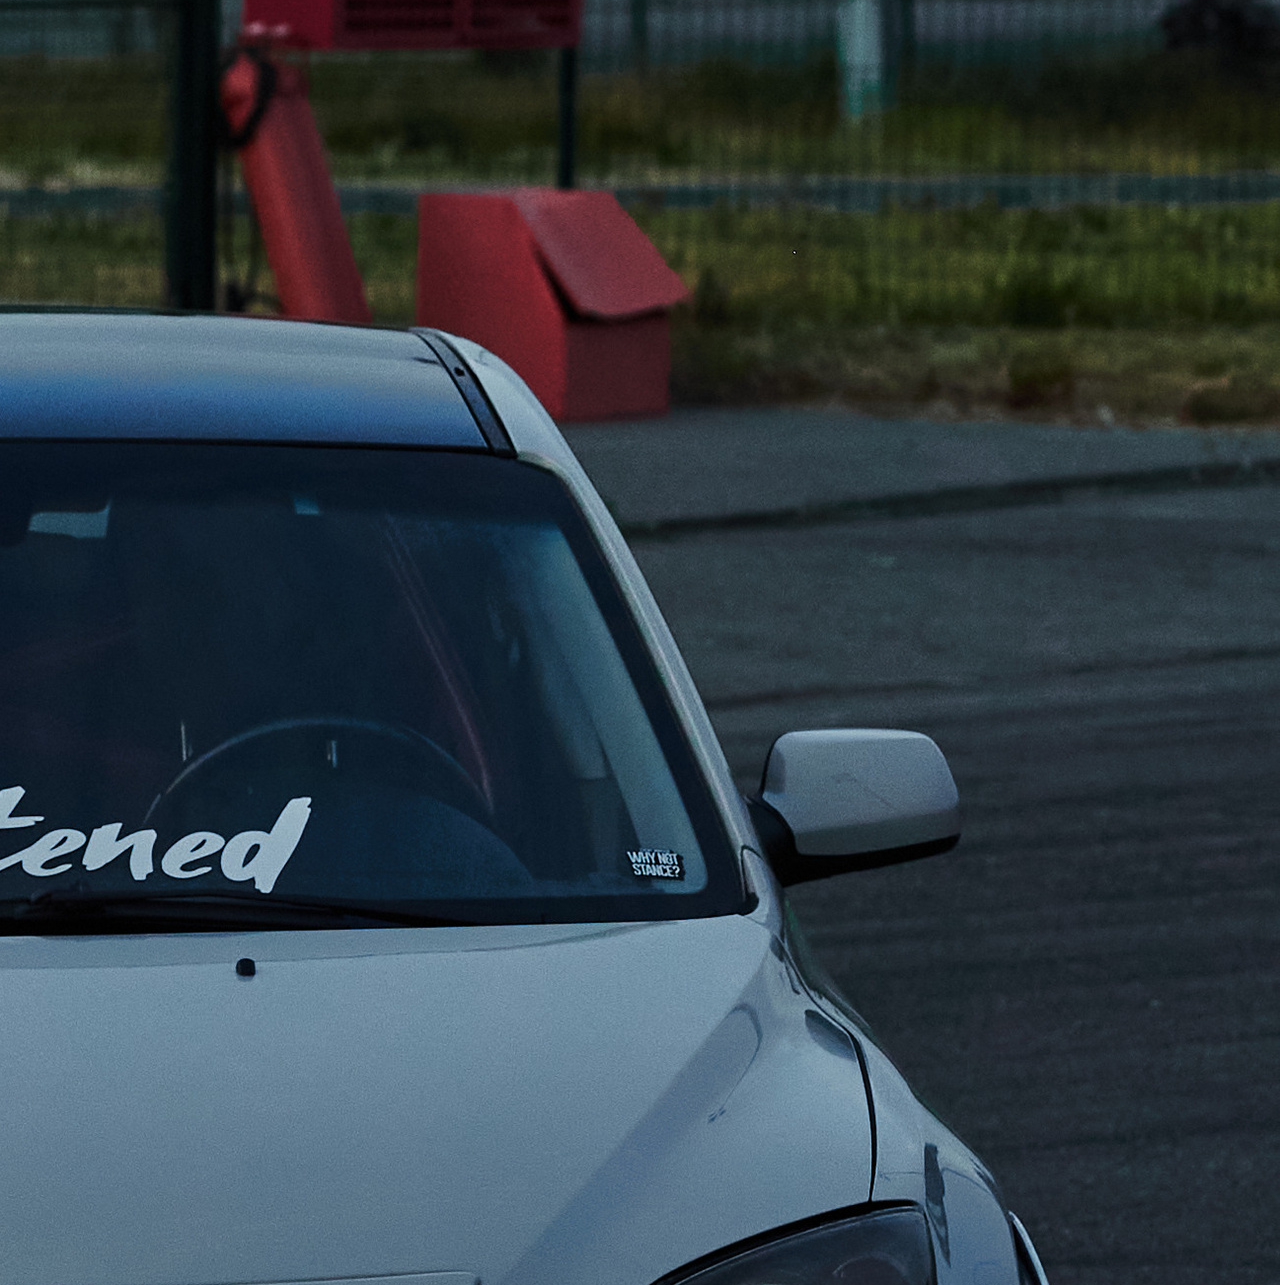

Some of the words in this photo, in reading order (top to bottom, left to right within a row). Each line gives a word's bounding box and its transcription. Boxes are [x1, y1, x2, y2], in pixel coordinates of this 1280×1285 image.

[626, 850, 656, 865] WHY
[656, 852, 679, 865] NOT
[631, 863, 681, 878] STANCE?
